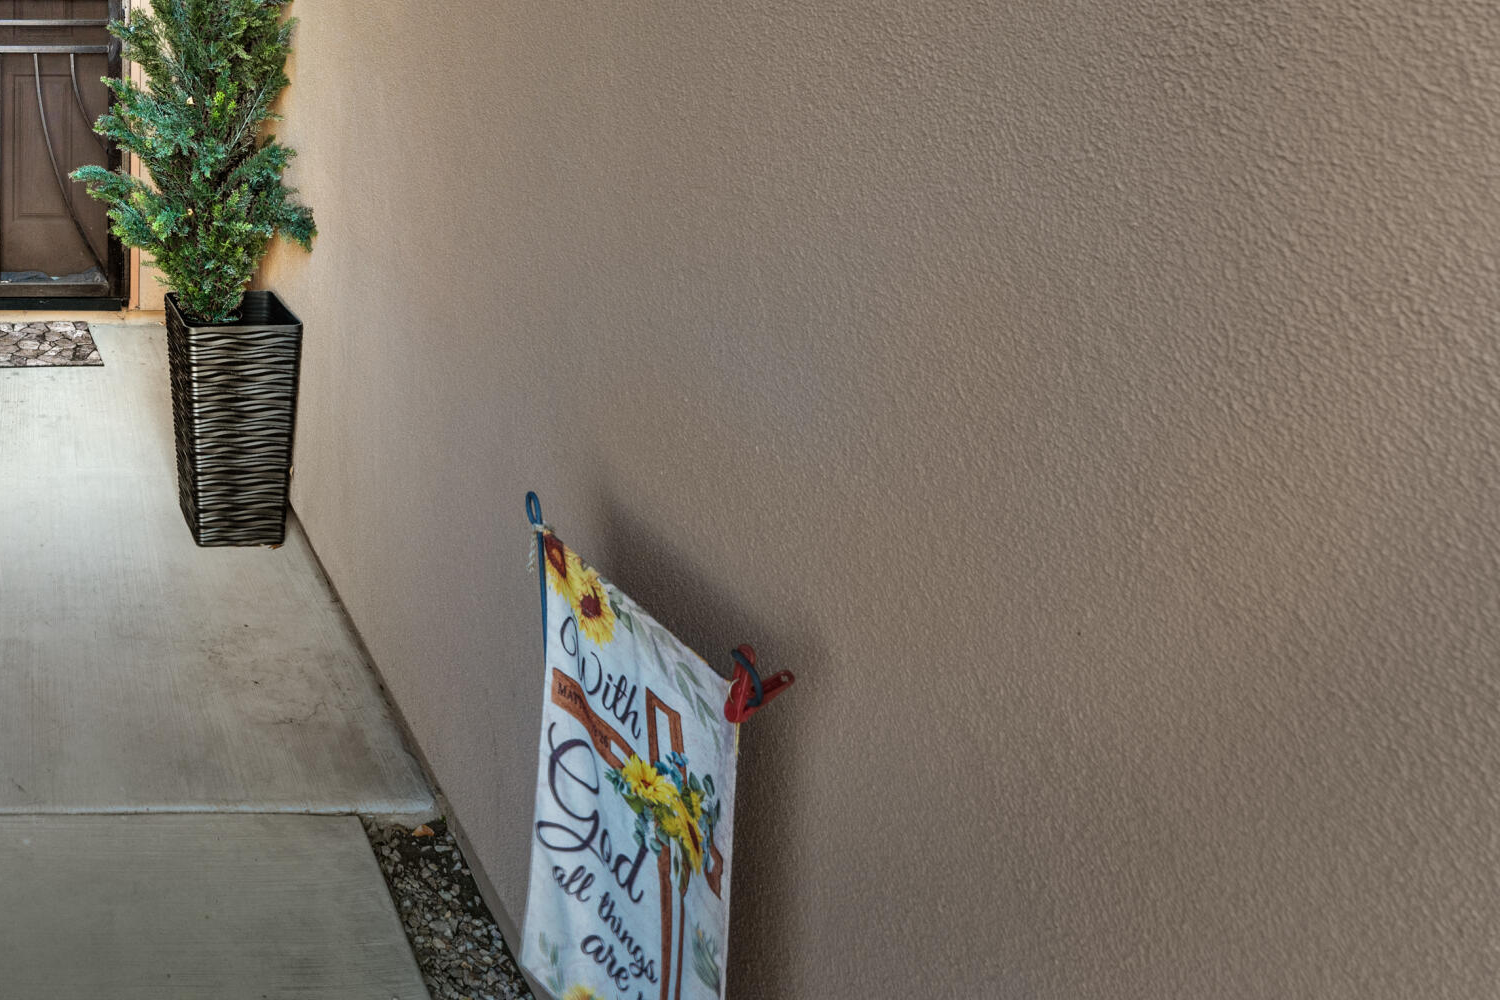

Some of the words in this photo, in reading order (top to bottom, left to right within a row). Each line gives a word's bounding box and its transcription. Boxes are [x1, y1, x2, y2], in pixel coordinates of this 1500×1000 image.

[559, 615, 642, 741] With
[535, 721, 649, 905] God
[552, 864, 593, 903] all
[580, 934, 630, 992] are
[597, 891, 659, 984] things
